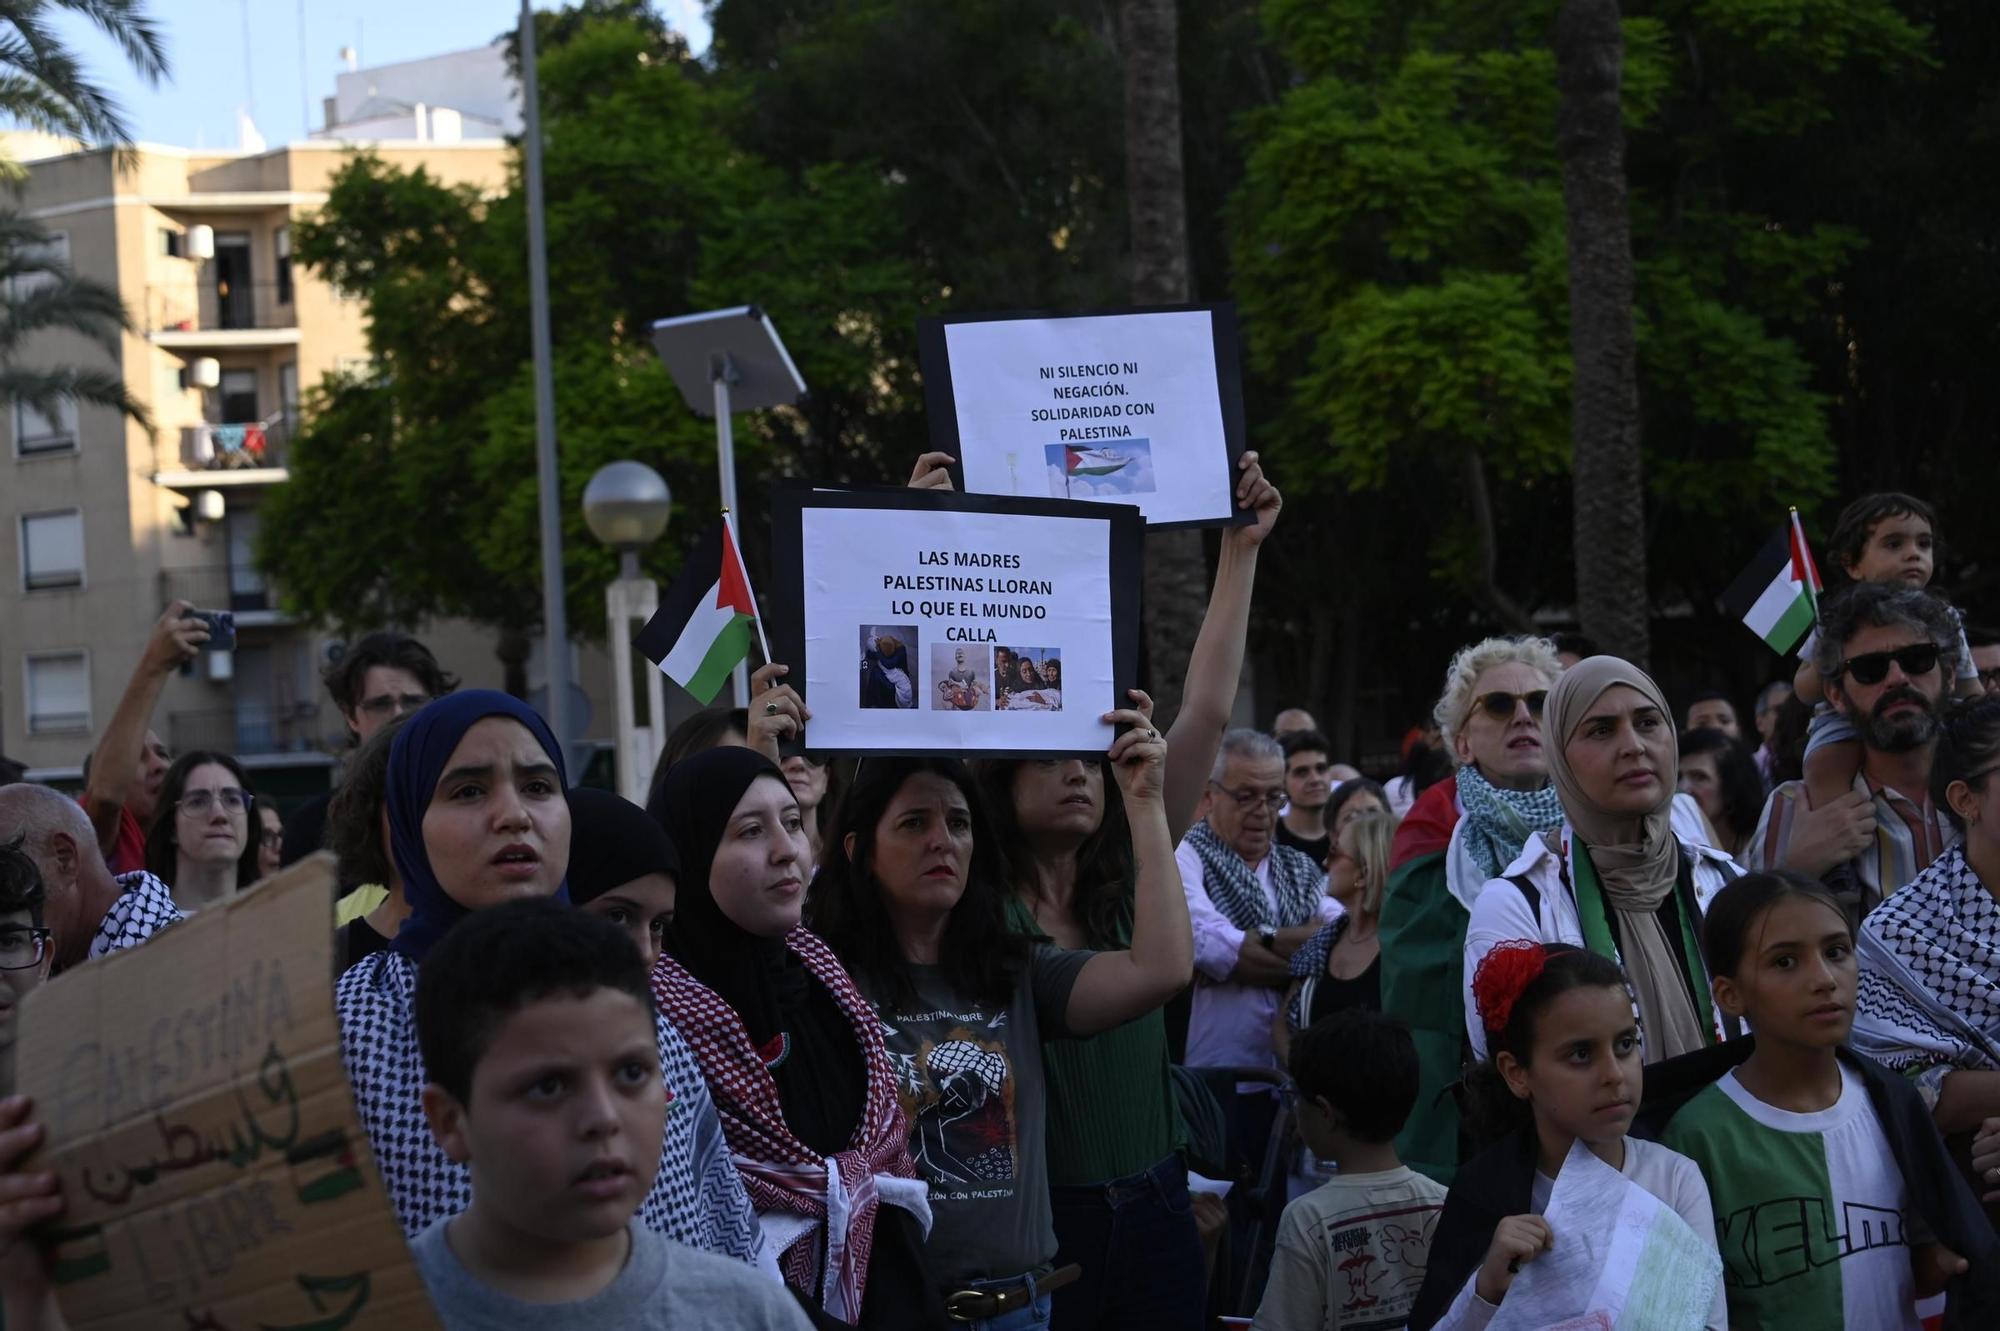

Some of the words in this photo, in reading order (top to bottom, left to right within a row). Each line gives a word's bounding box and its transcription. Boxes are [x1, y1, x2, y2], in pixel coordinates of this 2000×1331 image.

[1039, 367, 1055, 380] NI
[1058, 363, 1119, 379] SILENCIO
[1123, 361, 1138, 375] NI
[1053, 381, 1129, 400] NEGACIÓN.
[1031, 404, 1122, 422] SOLIDARIDAD
[1125, 402, 1155, 416] CON
[1060, 425, 1132, 441] PALESTINA
[918, 550, 949, 566] LAS
[953, 552, 1021, 569] MADRES
[883, 575, 984, 593] PALESTINAS
[988, 578, 1053, 596] LLORAN
[891, 600, 915, 616] LO
[920, 600, 955, 619] QUE
[960, 602, 978, 617] EL
[982, 603, 1047, 620] MUNDO
[946, 626, 998, 643] CALLA
[896, 1010, 953, 1023] PALESTINA
[57, 958, 294, 1134] PALESTINA
[950, 1190, 969, 1201] CON
[1717, 1196, 1908, 1289] KELM
